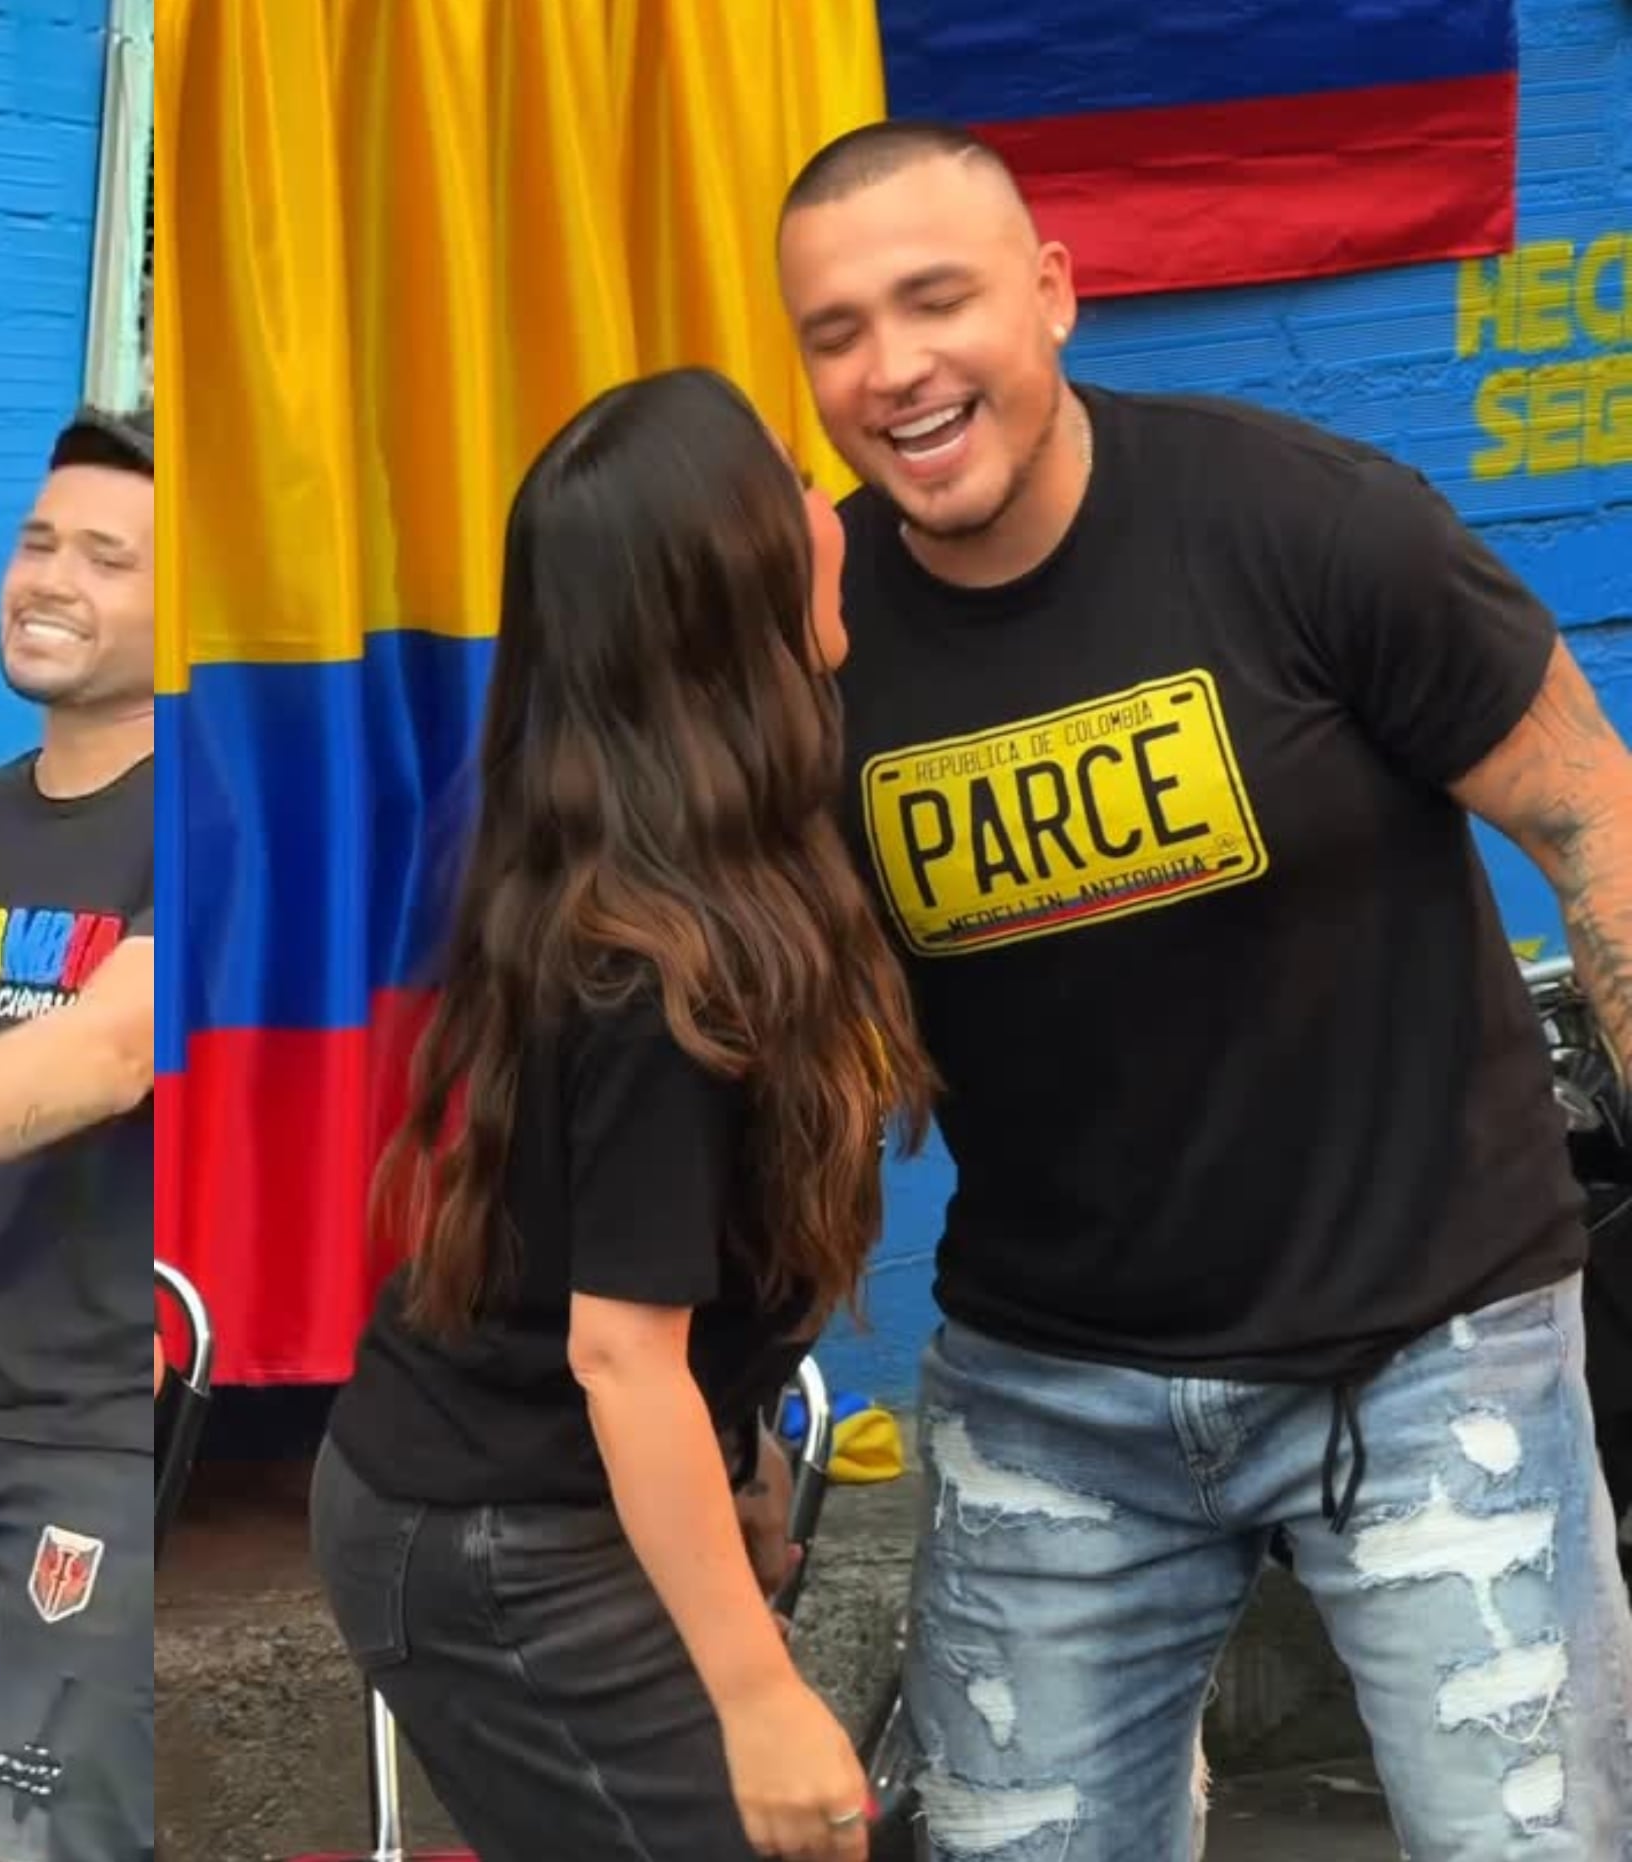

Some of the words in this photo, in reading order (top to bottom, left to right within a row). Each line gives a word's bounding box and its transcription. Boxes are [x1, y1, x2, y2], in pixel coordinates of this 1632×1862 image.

[915, 742, 1020, 785] REPUBLICA
[1030, 734, 1055, 758] DE
[1065, 700, 1155, 747] COLOMBIA
[898, 721, 1212, 909] PARCE
[946, 891, 1064, 935] MEDELLIN
